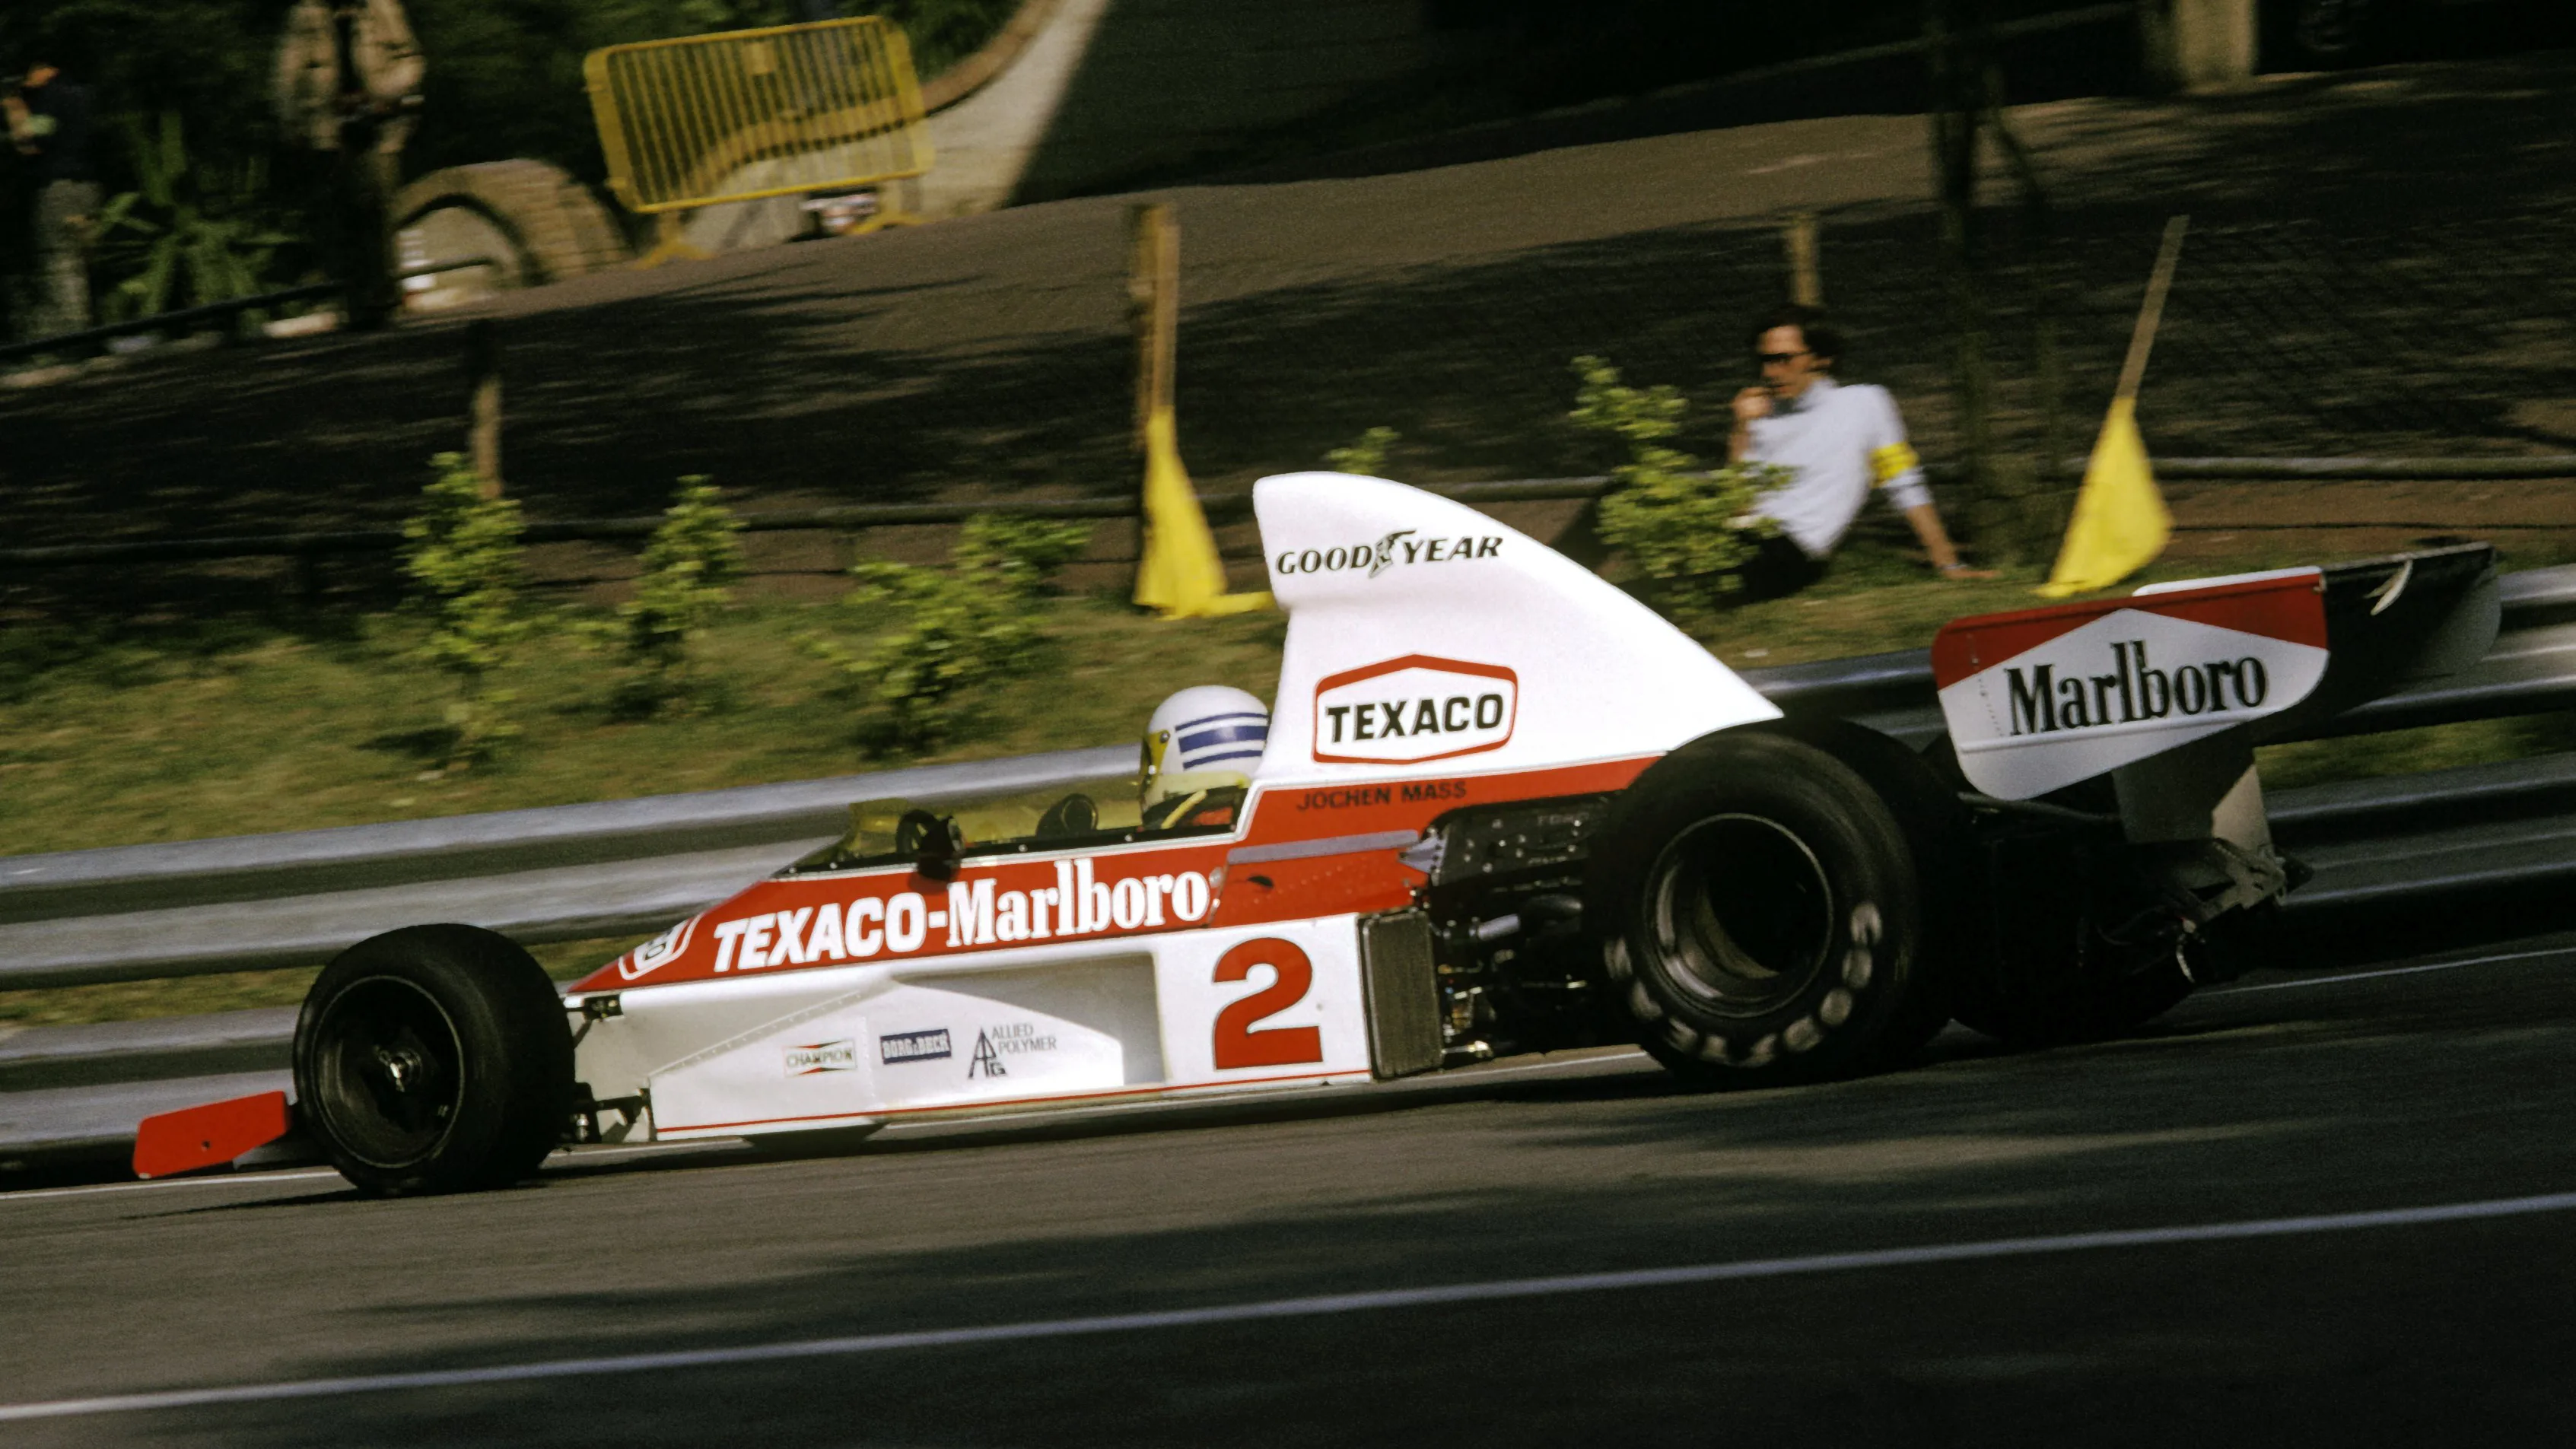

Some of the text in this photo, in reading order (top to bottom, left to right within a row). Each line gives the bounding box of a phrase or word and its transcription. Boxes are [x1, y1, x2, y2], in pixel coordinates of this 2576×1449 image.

[2004, 640, 2269, 736] Marlboro
[1325, 693, 1504, 743] TEXACO
[1296, 780, 1467, 812] JOCHEN MASS
[1211, 936, 1324, 1070] 2
[992, 1023, 1034, 1040] ALLIED
[998, 1034, 1057, 1054] POLYMER
[787, 1047, 854, 1067] CHAMPION
